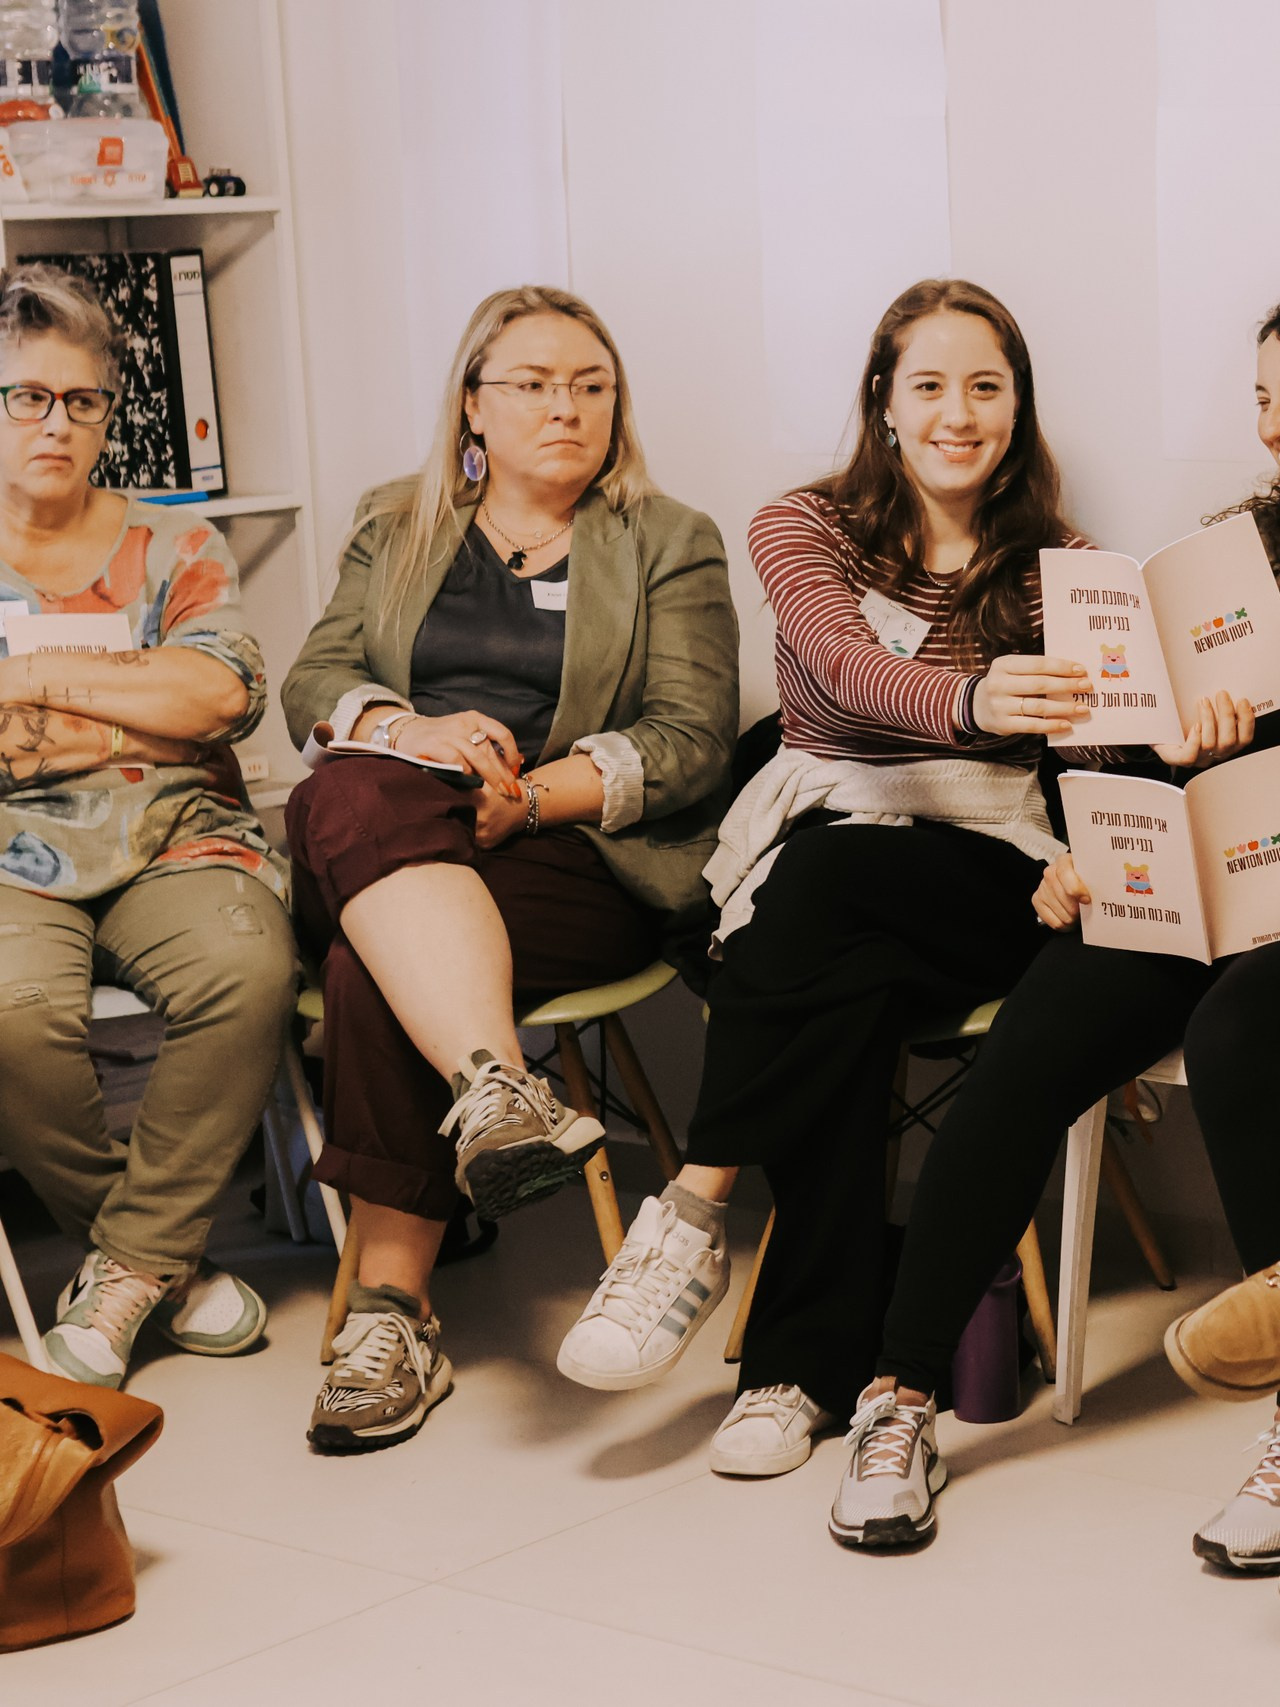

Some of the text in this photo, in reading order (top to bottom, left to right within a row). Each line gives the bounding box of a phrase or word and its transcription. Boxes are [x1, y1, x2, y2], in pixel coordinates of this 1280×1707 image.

[1070, 588, 1141, 609] אני מחנכת מובילה
[1088, 615, 1112, 631] ניוטון
[1193, 620, 1254, 654] ניוטון NEWTON
[1101, 691, 1120, 708] העל
[1122, 692, 1138, 707] כוח
[1141, 693, 1157, 708] ומה
[1090, 810, 1168, 833] אני מחנכת מובילה
[1110, 836, 1135, 851] ניוטון
[1226, 853, 1263, 874] NEWTON
[1101, 902, 1181, 925] ומה כוח העל שלך?
